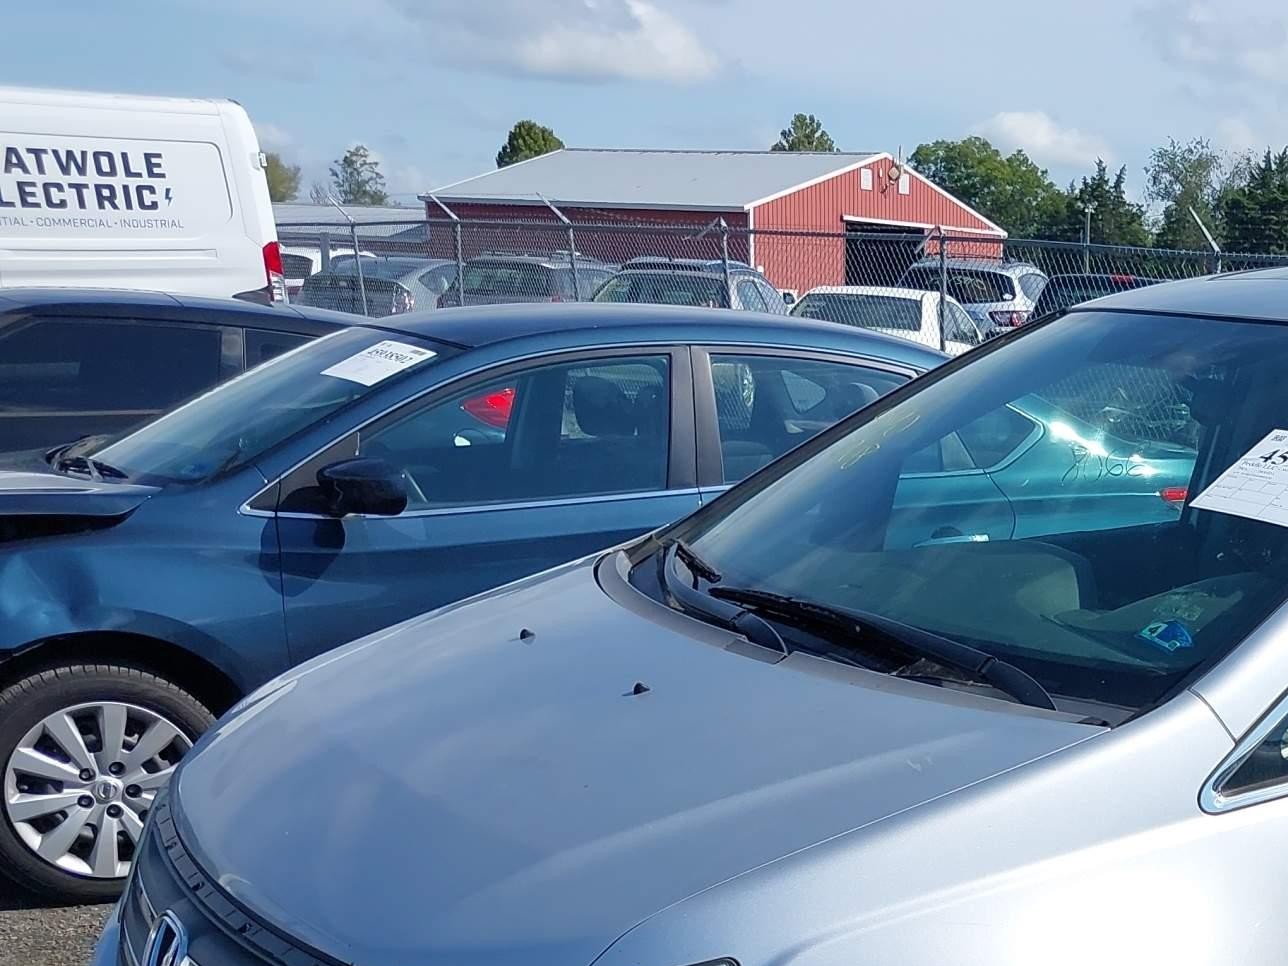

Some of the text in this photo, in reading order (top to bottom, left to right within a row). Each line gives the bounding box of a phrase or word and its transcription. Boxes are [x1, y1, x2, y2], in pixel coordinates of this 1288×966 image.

[4, 147, 167, 179] ATWOLE
[0, 216, 185, 230] TIAL COMMERCIAL INDUSTRIAL
